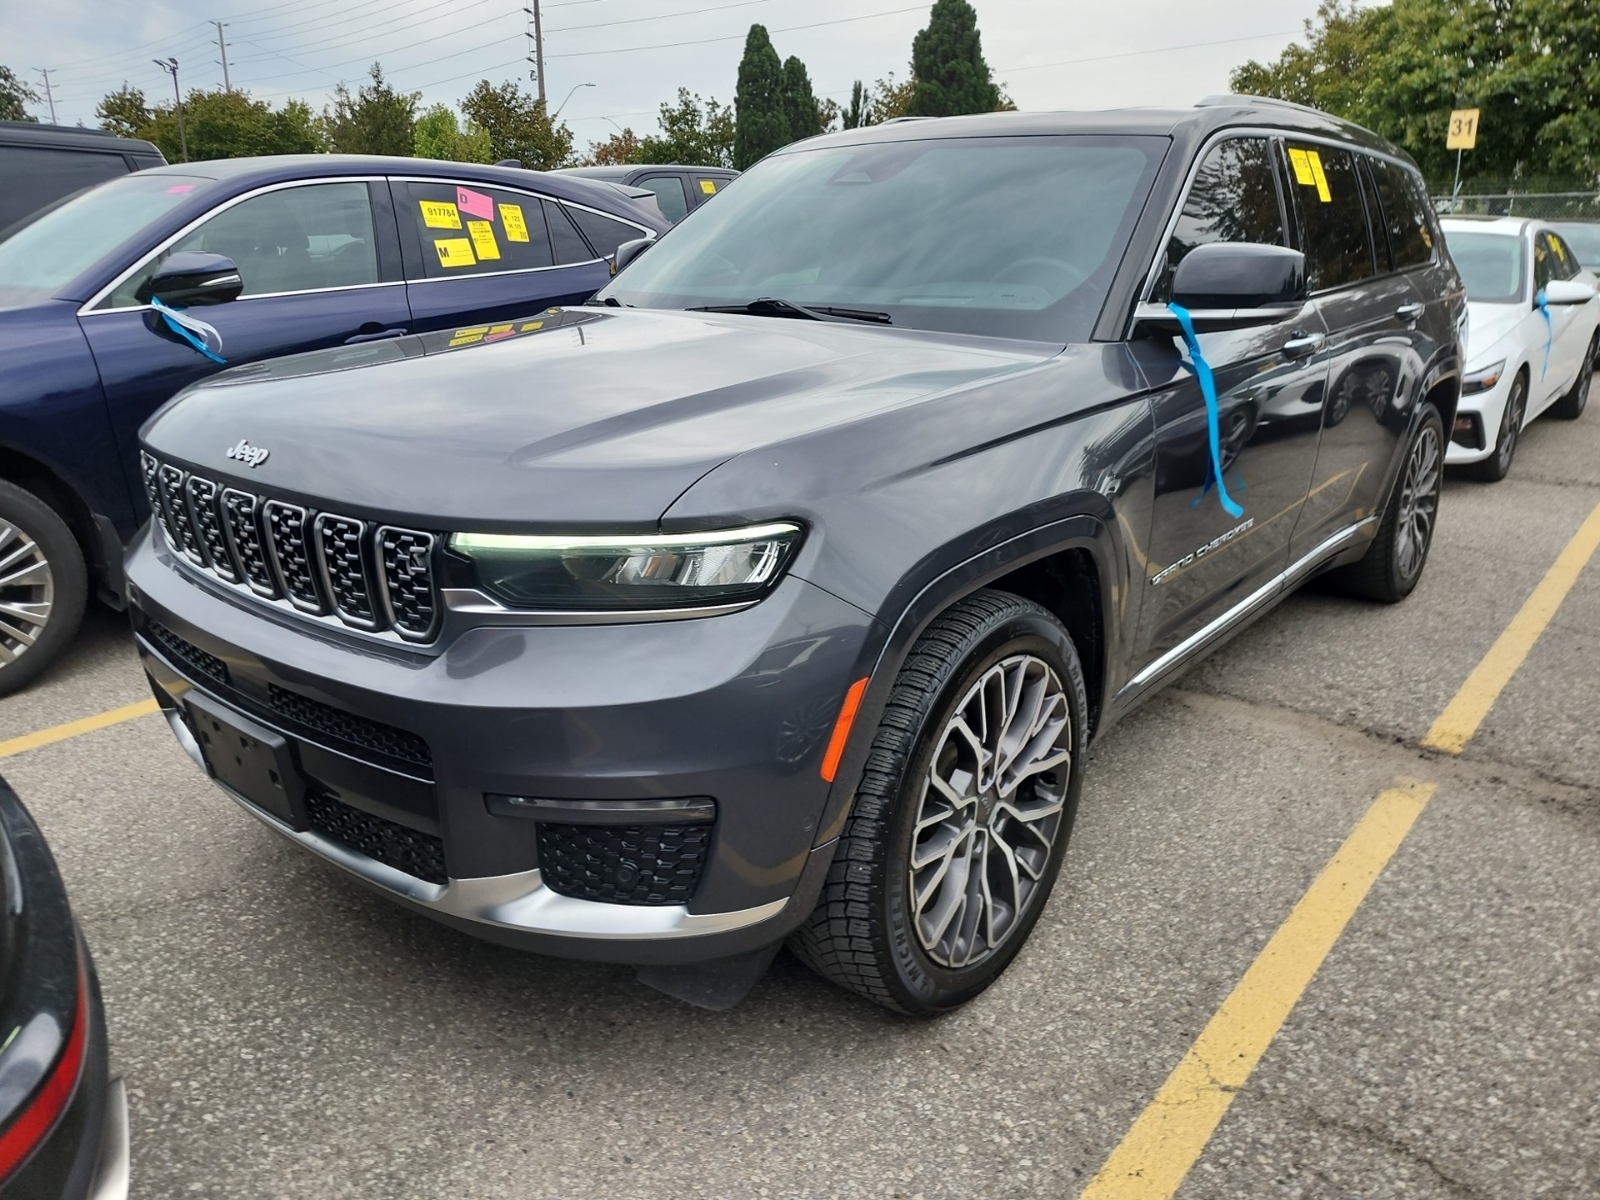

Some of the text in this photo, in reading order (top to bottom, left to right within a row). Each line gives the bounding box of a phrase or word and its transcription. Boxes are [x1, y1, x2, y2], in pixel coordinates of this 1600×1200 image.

[1451, 117, 1473, 137] 31
[459, 193, 468, 204] D
[427, 207, 456, 217] 917784
[438, 247, 450, 258] M
[226, 439, 270, 468] Jeep
[1196, 518, 1254, 558] CHEROKEE
[892, 868, 921, 983] MICHELIN
